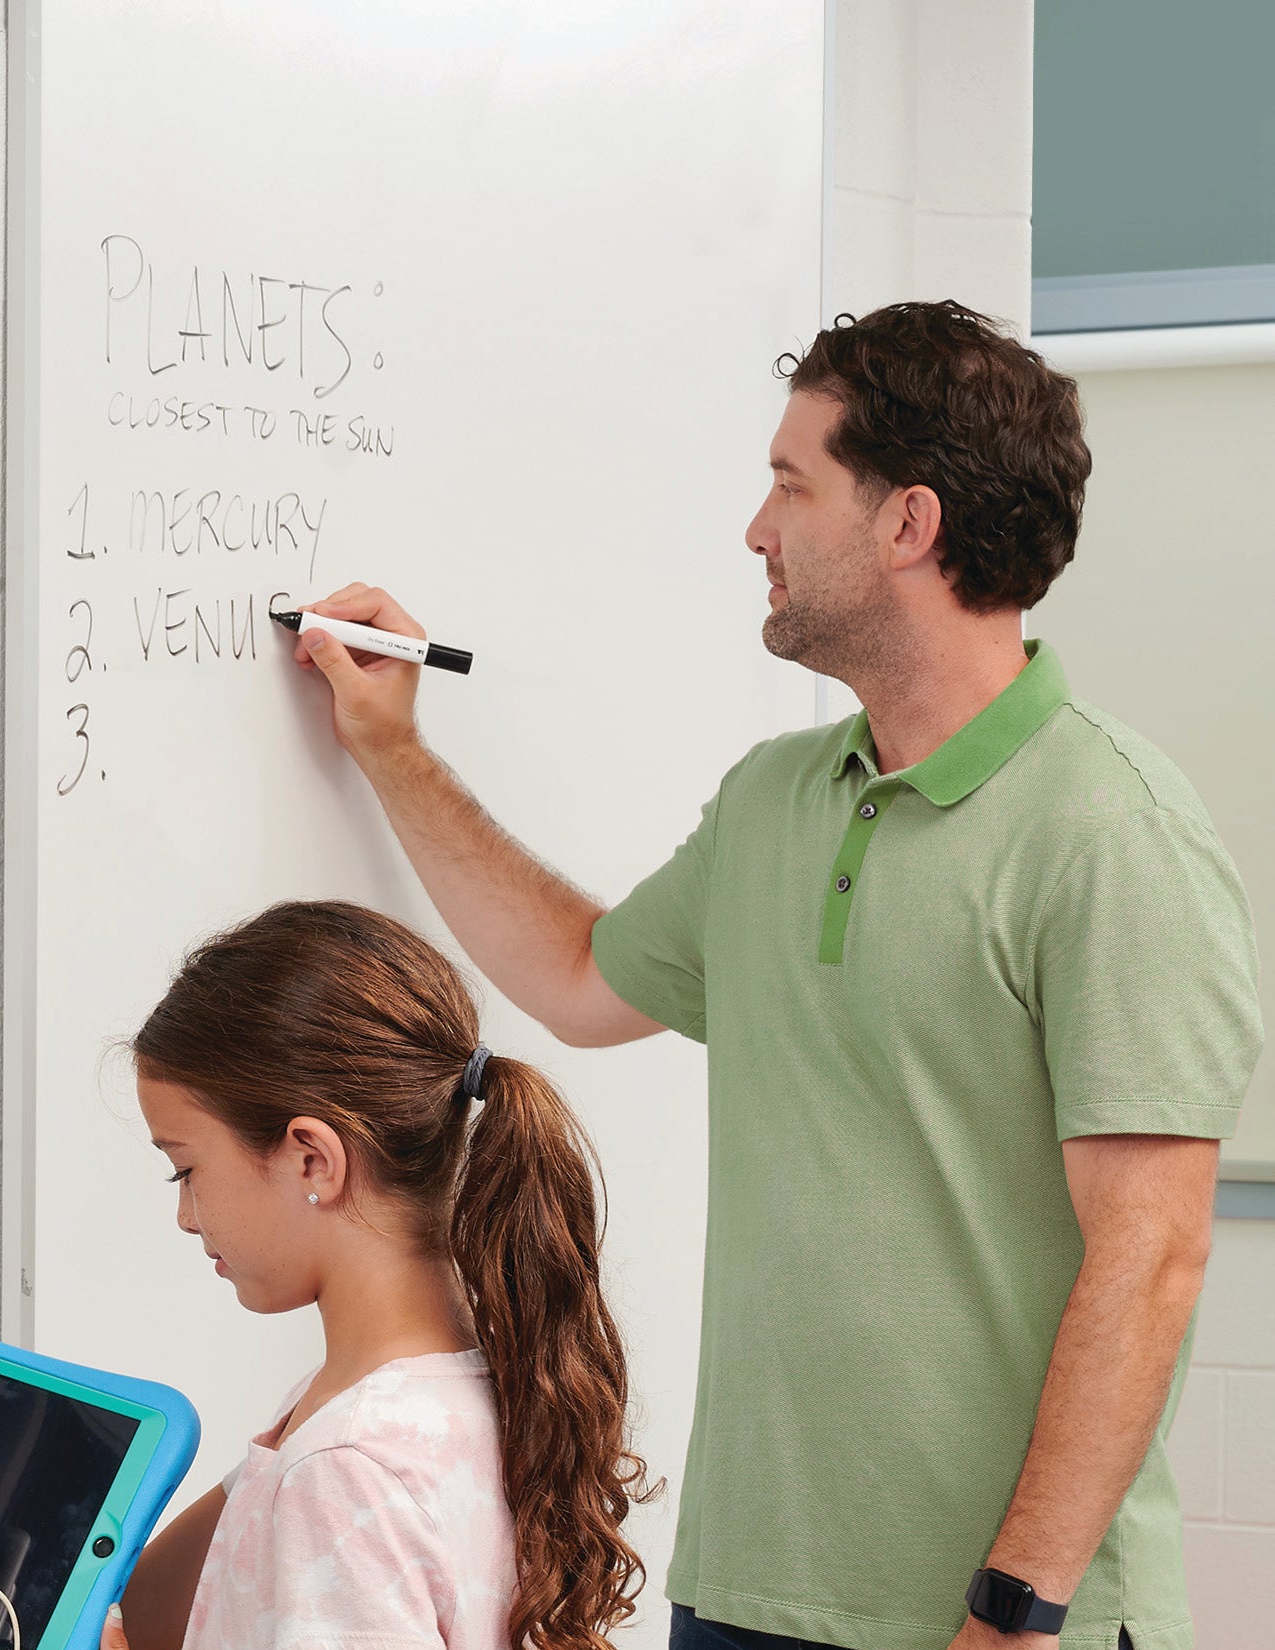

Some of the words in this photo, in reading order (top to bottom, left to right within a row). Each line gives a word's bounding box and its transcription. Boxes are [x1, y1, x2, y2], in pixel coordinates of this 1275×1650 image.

[108, 391, 232, 436] CLOSEST
[244, 406, 277, 439] TO
[290, 409, 336, 447] THE
[346, 415, 395, 457] SUN
[129, 487, 327, 584] MERCURY
